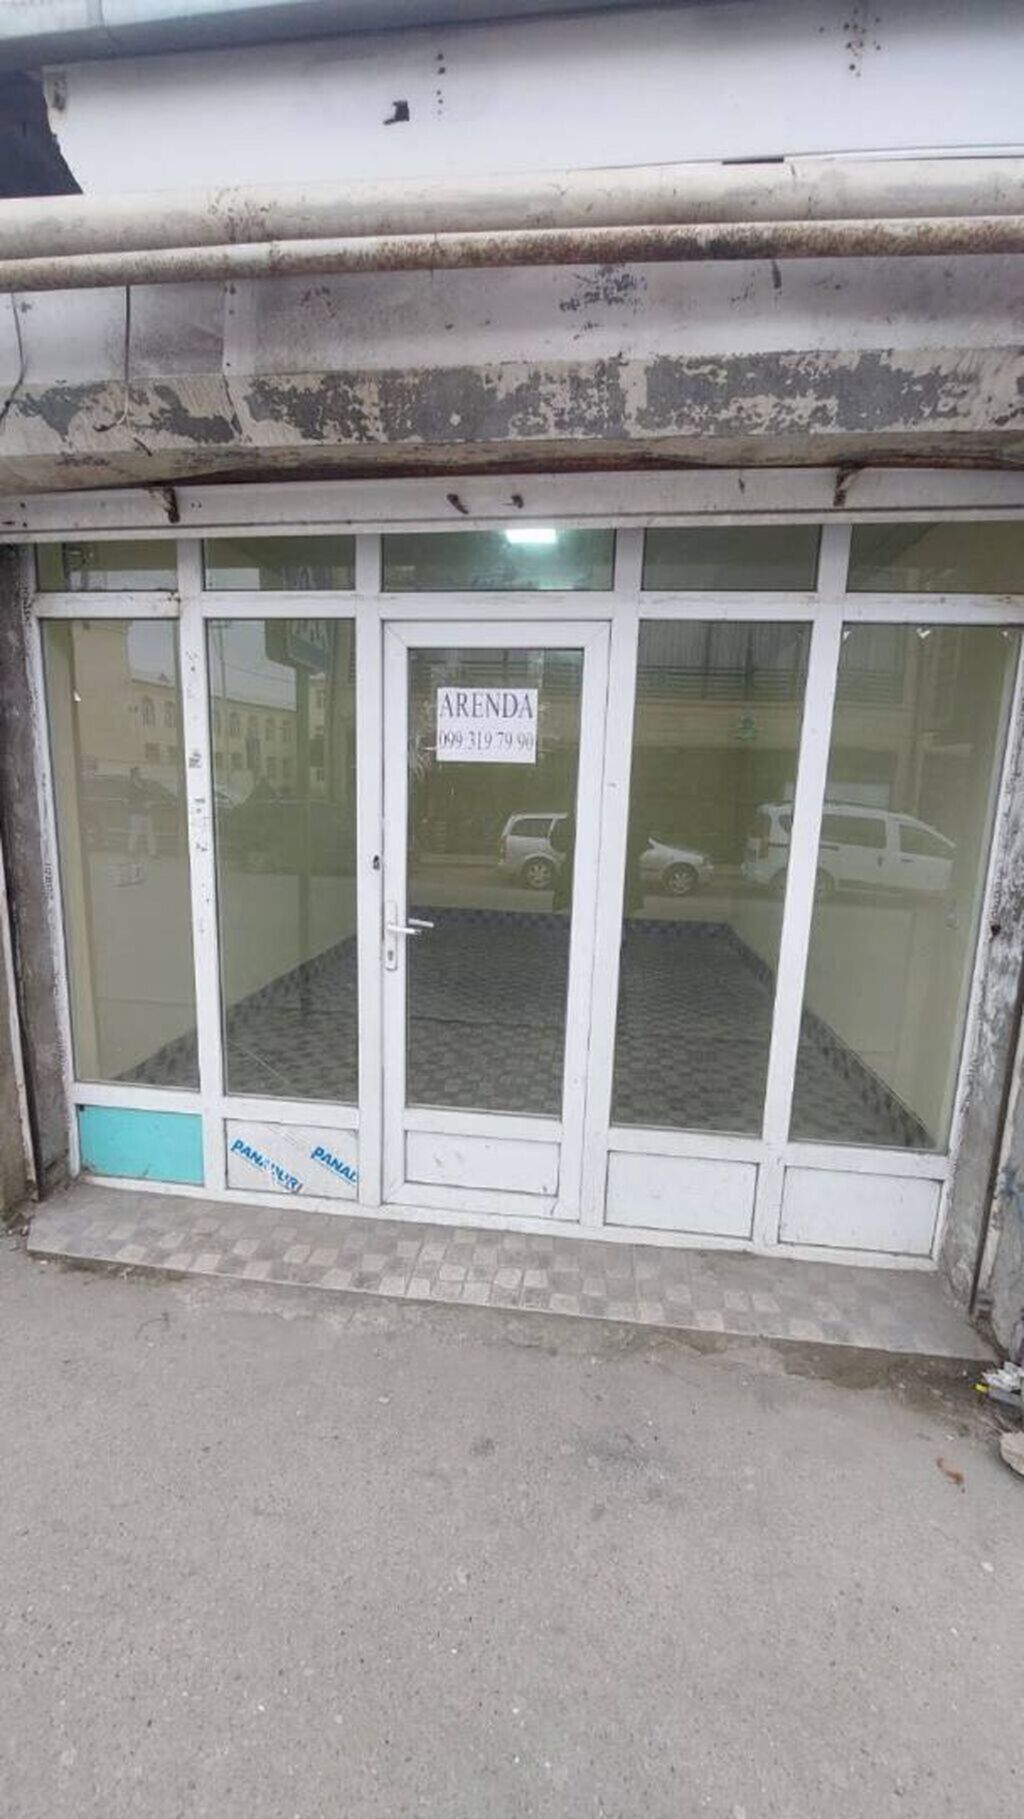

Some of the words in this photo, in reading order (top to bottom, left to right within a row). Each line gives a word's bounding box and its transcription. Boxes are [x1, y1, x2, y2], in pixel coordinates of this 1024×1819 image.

[440, 692, 534, 719] ARENDA
[439, 731, 463, 749] 099
[468, 731, 493, 750] 319
[497, 732, 513, 750] 79
[517, 732, 534, 751] 90
